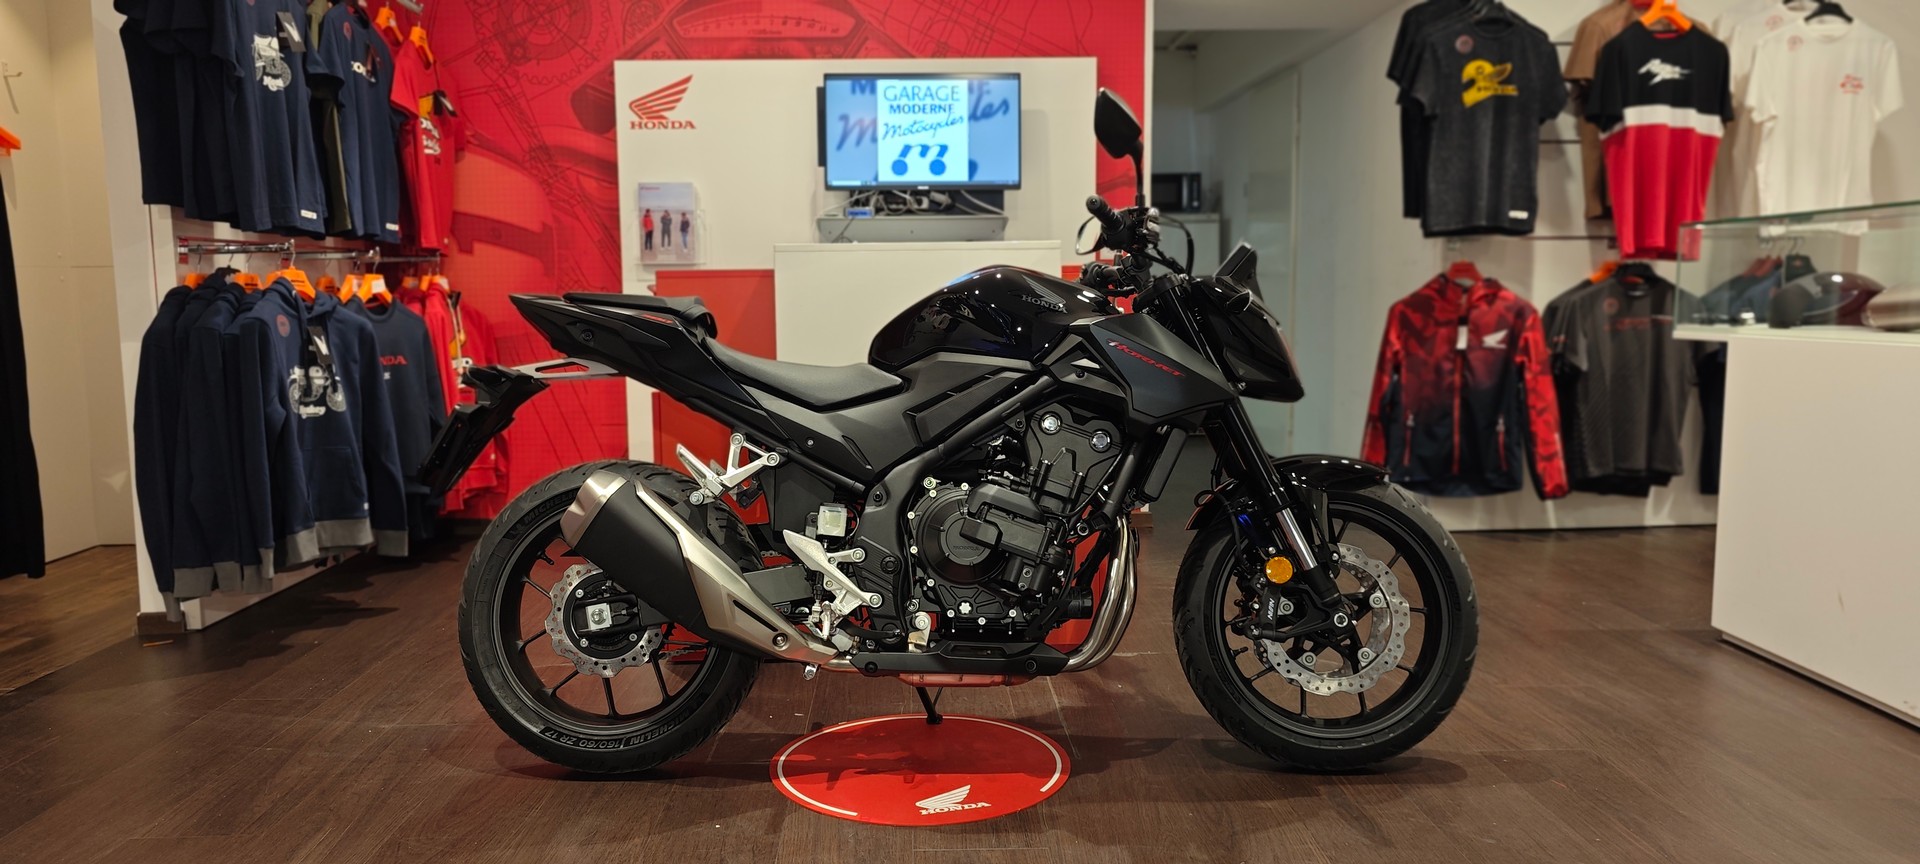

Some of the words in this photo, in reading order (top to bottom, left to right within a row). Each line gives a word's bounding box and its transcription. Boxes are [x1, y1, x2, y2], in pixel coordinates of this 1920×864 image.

[883, 85, 960, 102] GARAGE
[889, 103, 956, 115] MODERNE
[630, 120, 697, 130] HONDA
[881, 112, 965, 140] Motocycles
[1021, 294, 1068, 314] HONDA
[544, 731, 559, 741] 17
[559, 735, 578, 745] ZR
[579, 739, 620, 749] 160/60
[919, 802, 992, 815] HONDA
